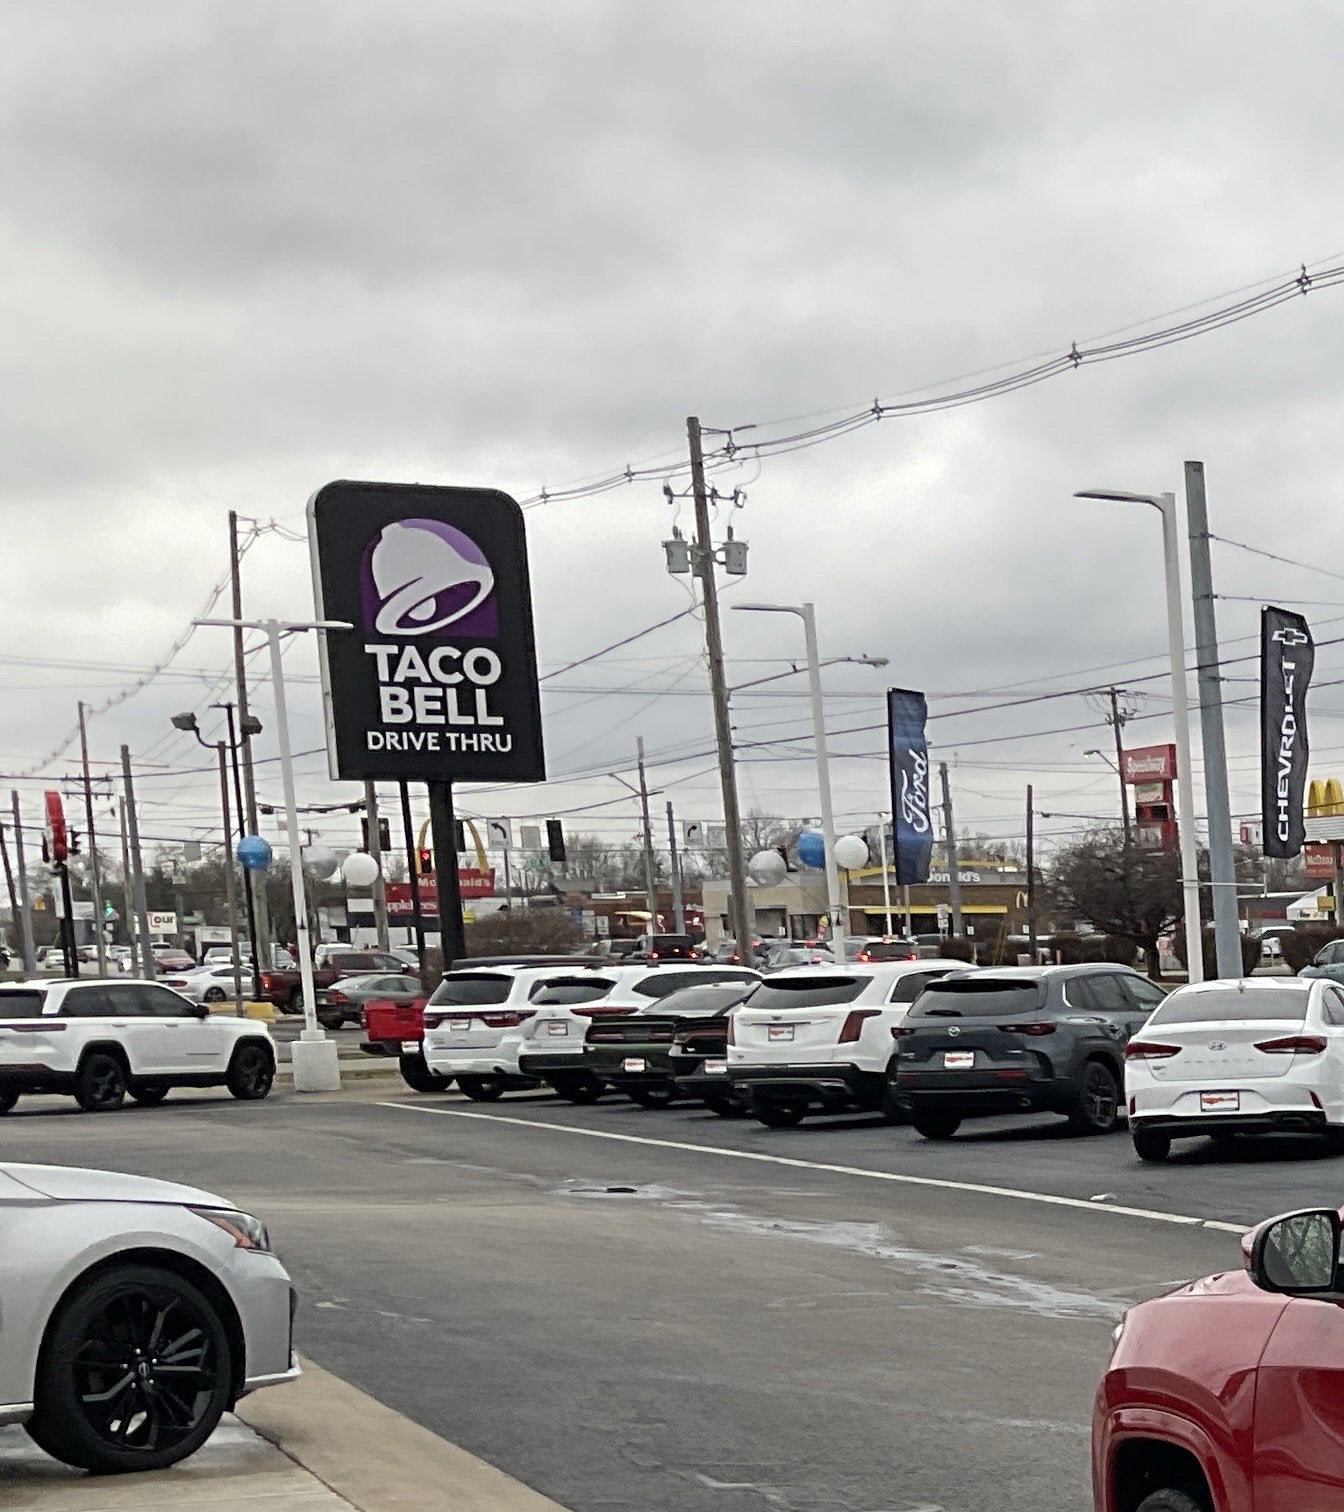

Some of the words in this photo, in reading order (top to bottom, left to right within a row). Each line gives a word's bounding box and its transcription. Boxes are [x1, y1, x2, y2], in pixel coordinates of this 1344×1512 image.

[364, 644, 502, 686] TACO
[379, 685, 504, 726] BELL
[366, 731, 441, 751] DRIVE
[445, 732, 513, 752] THRU
[901, 748, 929, 833] Ford
